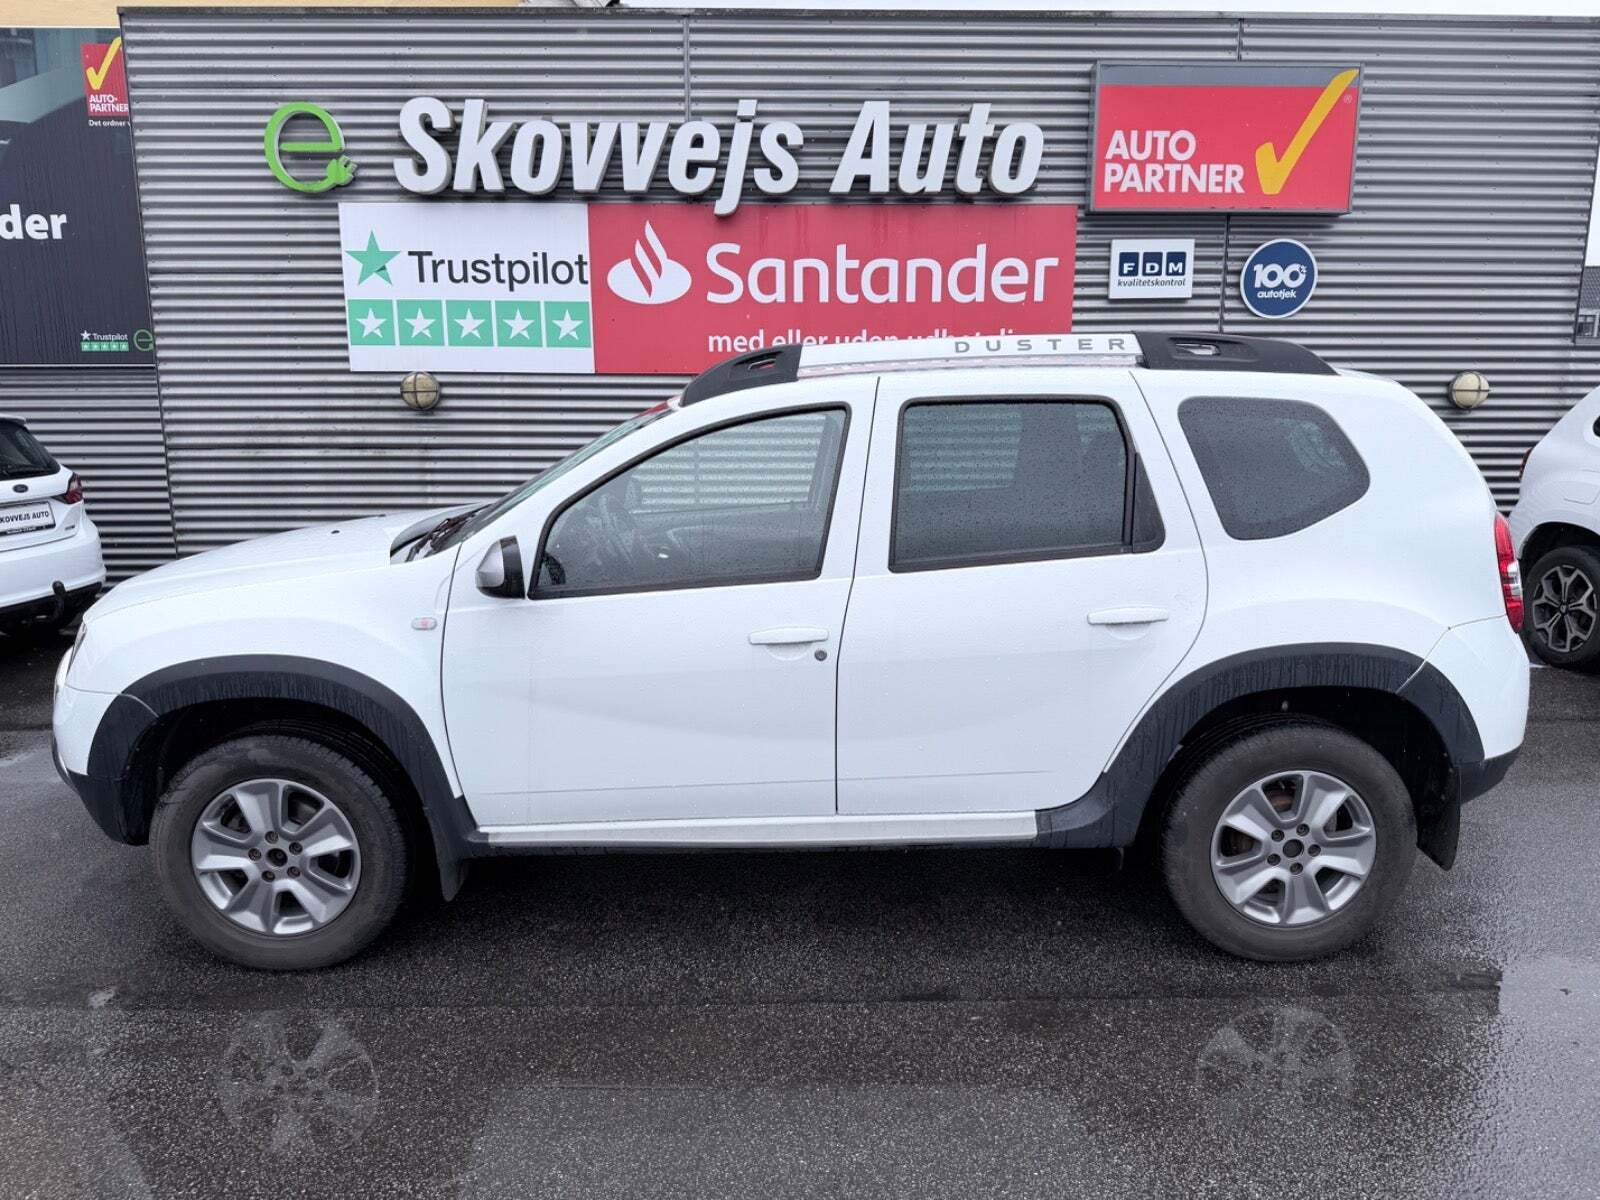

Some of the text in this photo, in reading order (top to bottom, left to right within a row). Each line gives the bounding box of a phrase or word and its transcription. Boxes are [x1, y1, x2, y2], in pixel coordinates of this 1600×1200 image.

[89, 94, 118, 103] AUTO-
[88, 119, 101, 127] Det
[1105, 129, 1197, 161] AUTO
[393, 97, 1045, 217] Skovvejs Auto
[1103, 163, 1246, 193] PARTNER
[408, 250, 588, 291] Trustpilot
[706, 243, 1060, 304] Santander
[1117, 277, 1186, 288] kvalitetskontrol
[1257, 289, 1297, 300] autotjek
[92, 333, 128, 341] Trustpilot
[708, 328, 764, 353] med
[954, 338, 1126, 353] DUSTER
[32, 510, 50, 519] AUTO
